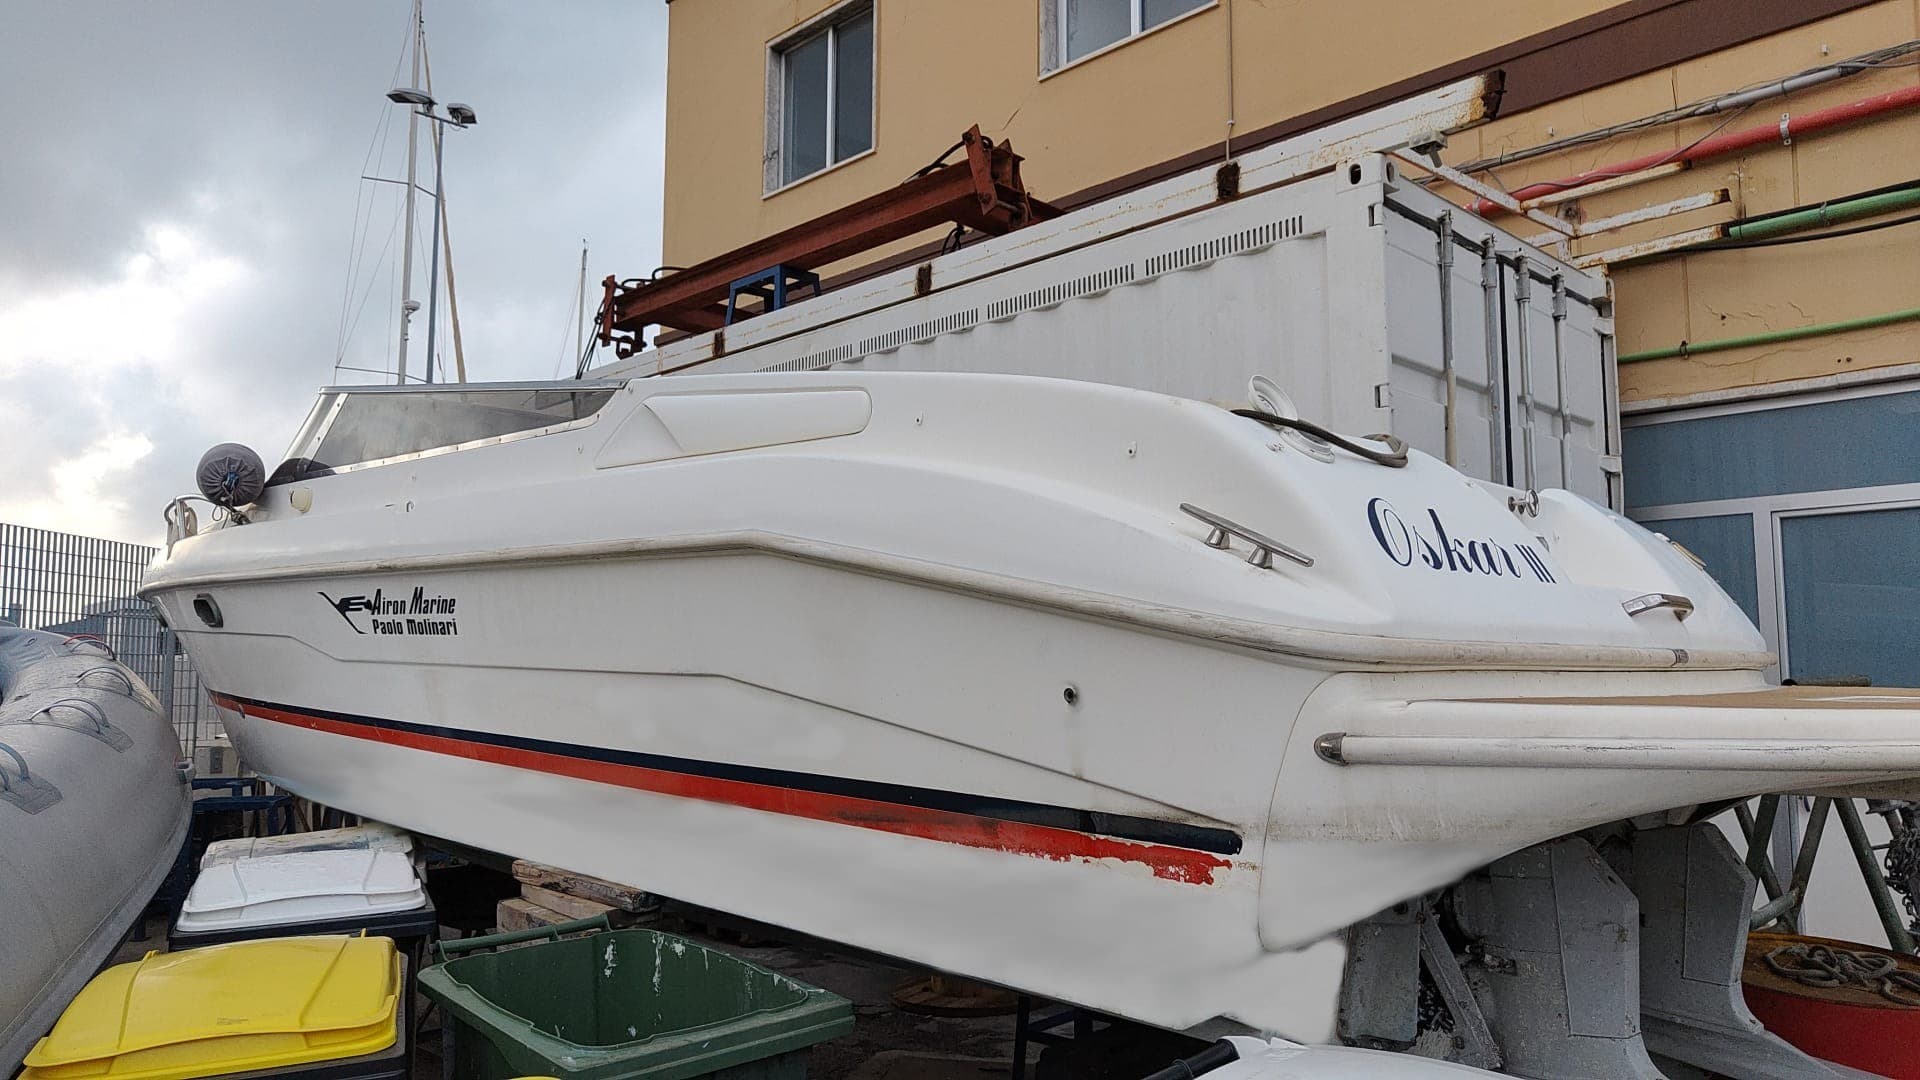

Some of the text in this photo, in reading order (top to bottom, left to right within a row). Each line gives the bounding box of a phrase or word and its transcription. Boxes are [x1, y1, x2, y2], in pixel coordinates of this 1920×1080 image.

[1367, 497, 1522, 579] Oskar
[371, 586, 456, 616] Airon Marine
[372, 618, 458, 636] Paolo Molinari
